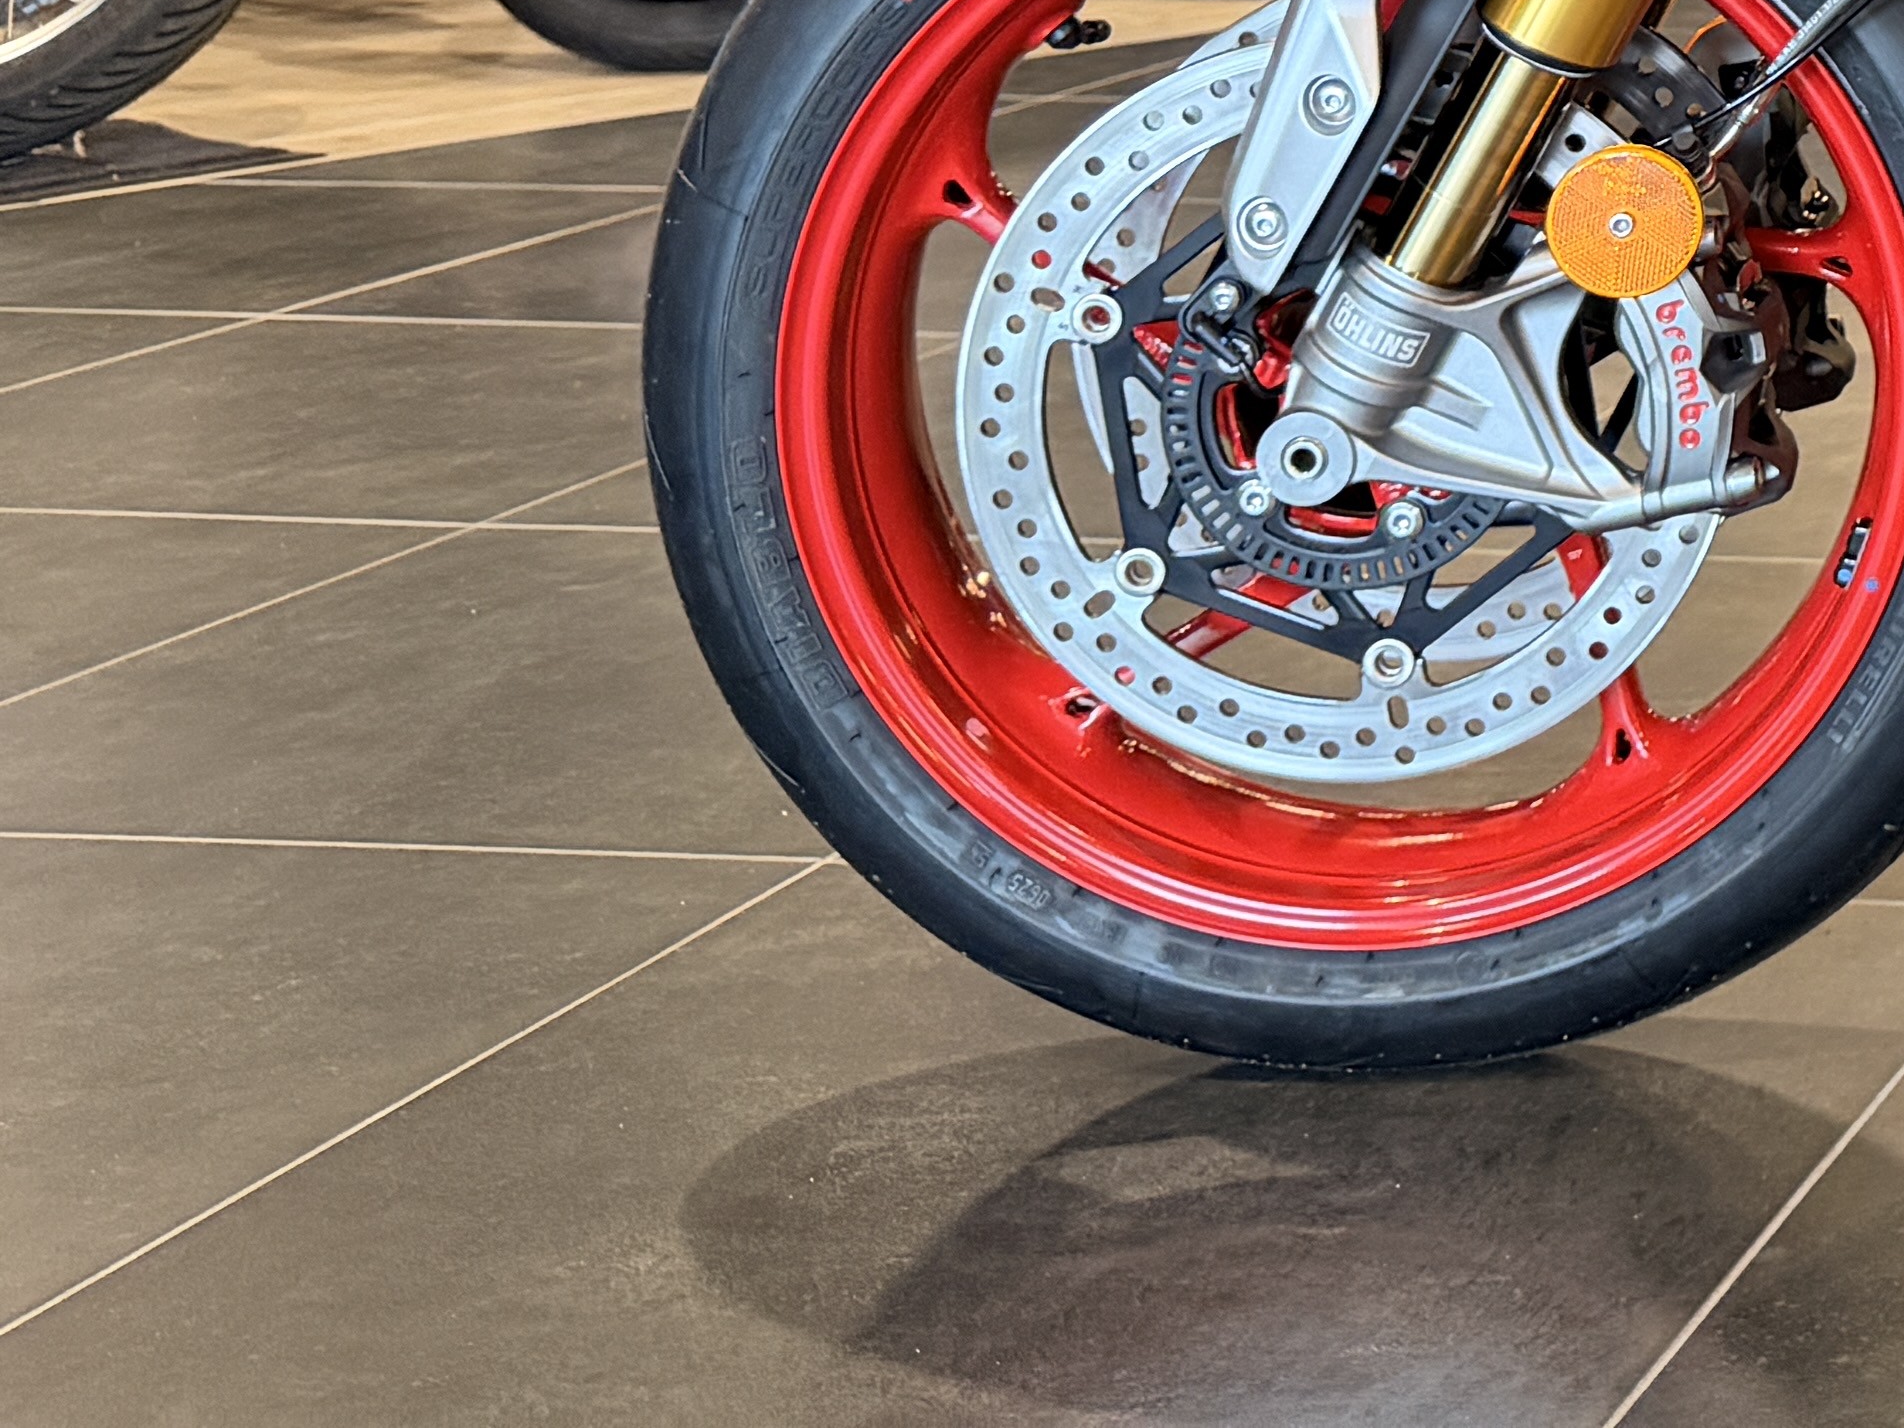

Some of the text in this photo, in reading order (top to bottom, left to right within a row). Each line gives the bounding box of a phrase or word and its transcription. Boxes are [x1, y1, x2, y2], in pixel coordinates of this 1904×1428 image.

[1333, 299, 1420, 362] ÖHLINS
[1655, 298, 1710, 450] brembo
[731, 437, 849, 712] DIABLO
